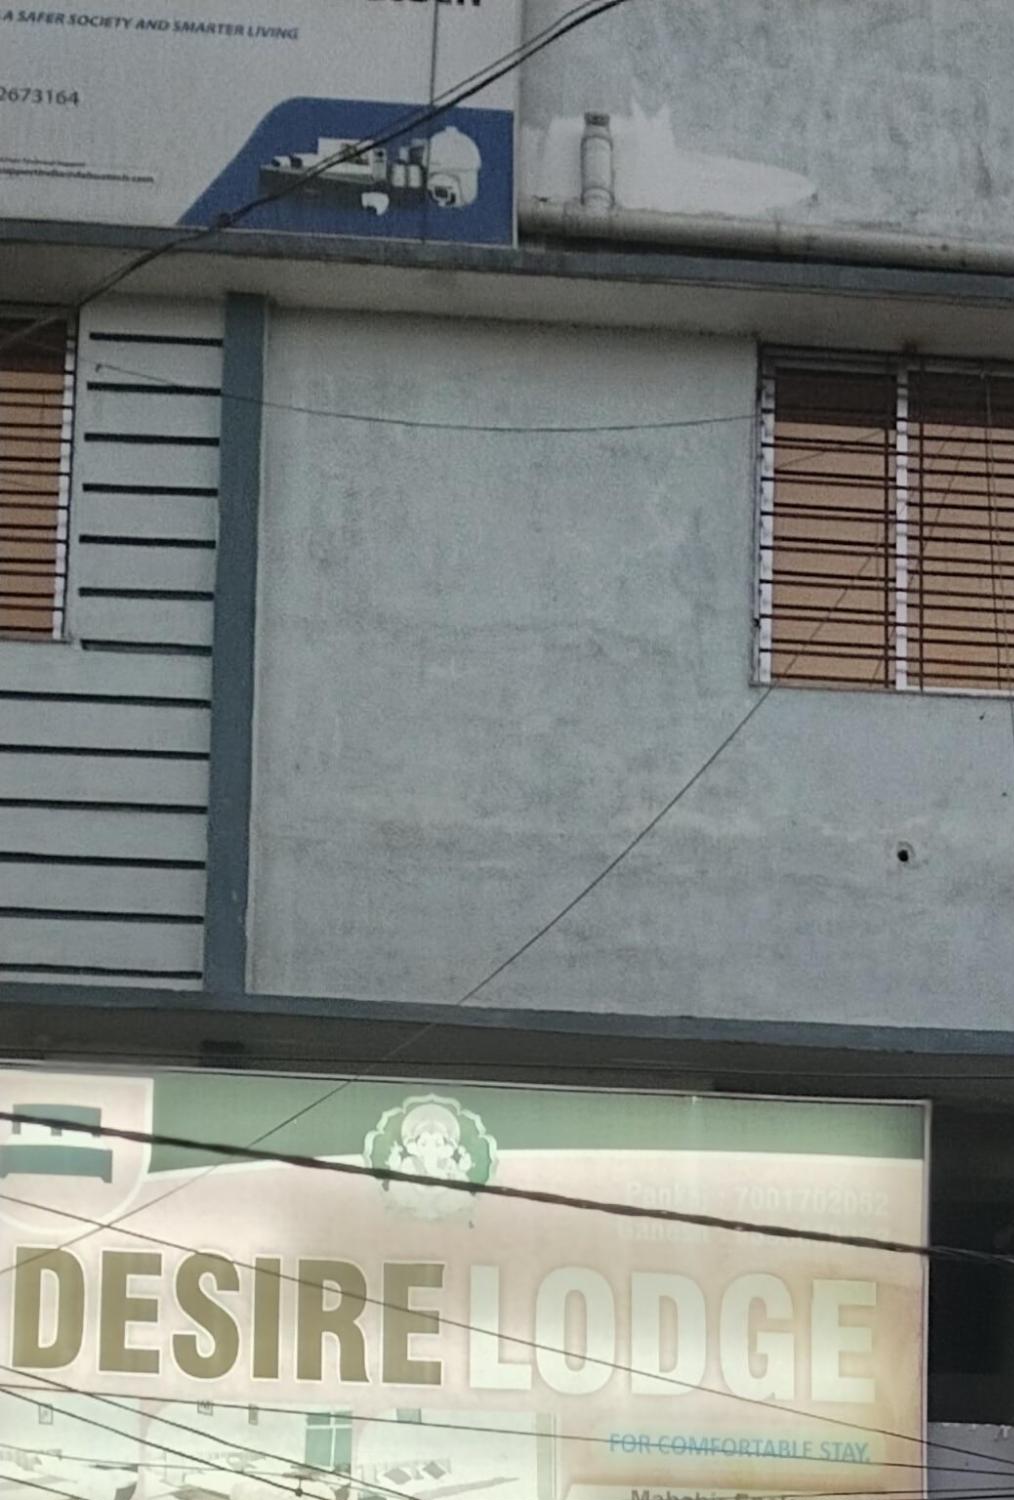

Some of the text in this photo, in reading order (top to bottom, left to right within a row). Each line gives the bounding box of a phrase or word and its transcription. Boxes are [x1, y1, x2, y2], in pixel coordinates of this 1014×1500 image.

[18, 10, 65, 24] SAFER
[68, 13, 132, 29] SOCIETY
[135, 19, 170, 32] AND
[173, 20, 245, 36] SMARTER
[247, 26, 299, 40] LIVING
[12, 1245, 878, 1405] DESIRE LODGE
[608, 1433, 871, 1464] FOR COMFORTABLE STAY.
